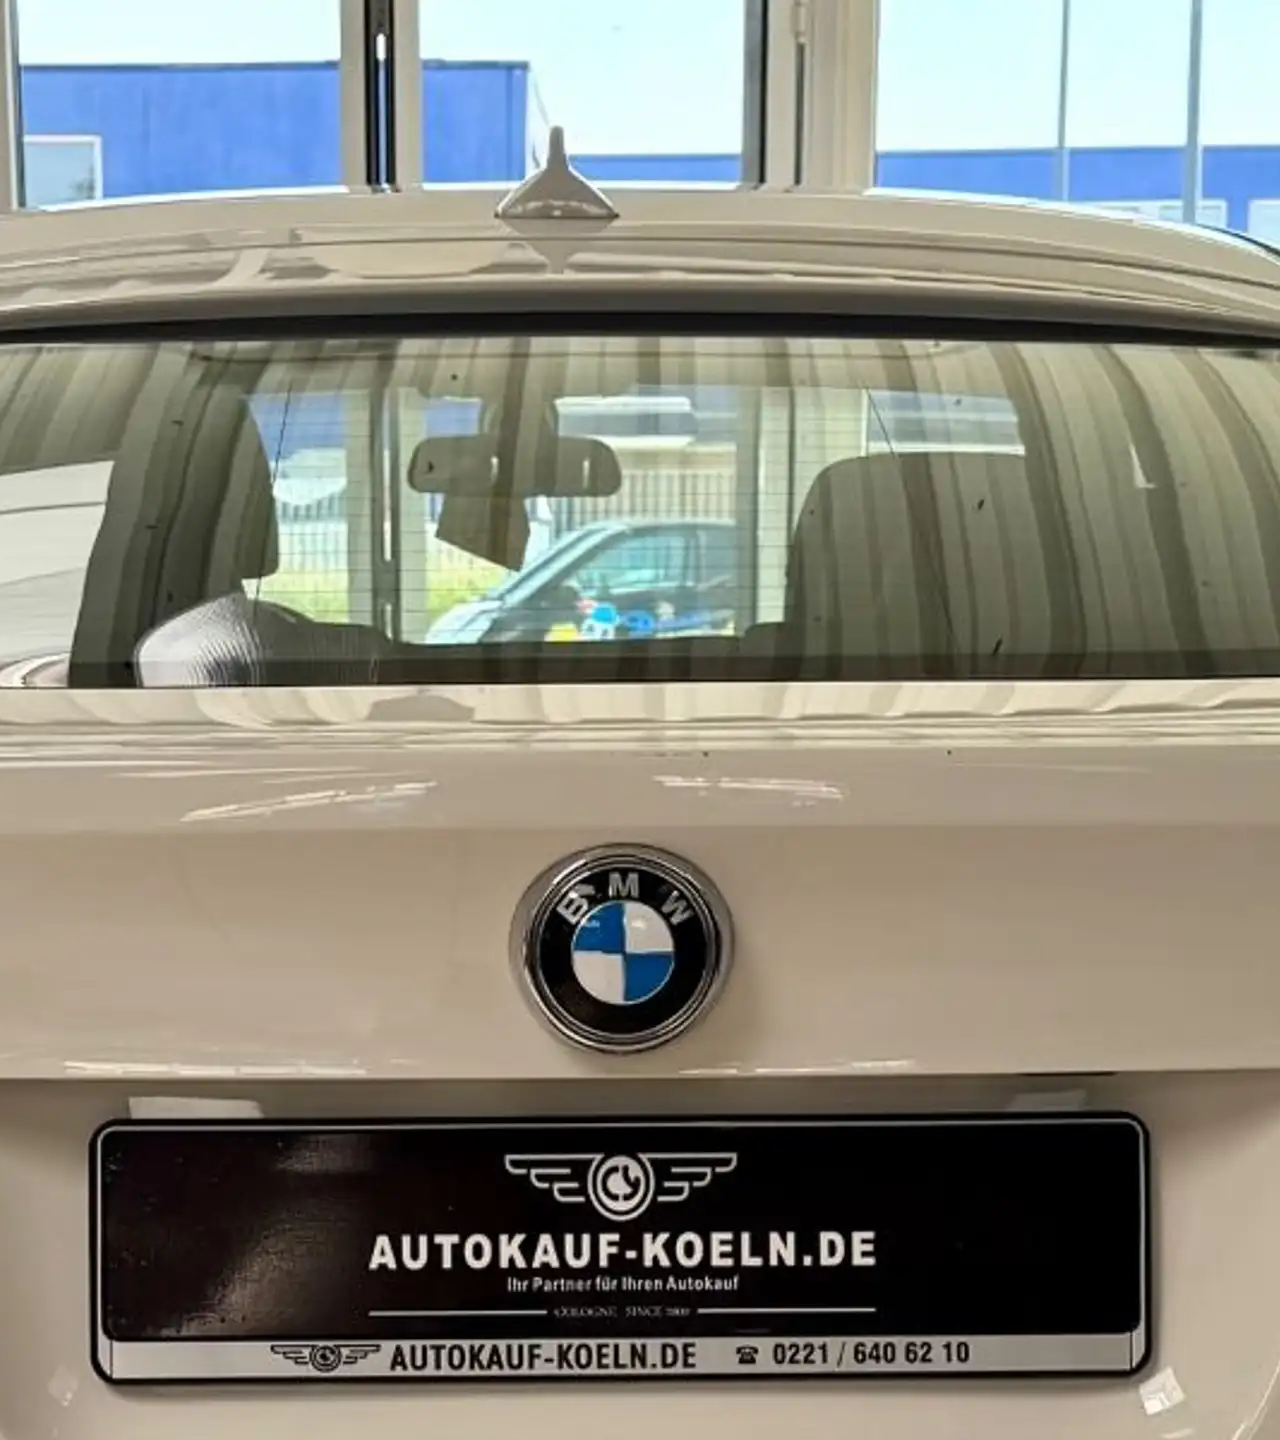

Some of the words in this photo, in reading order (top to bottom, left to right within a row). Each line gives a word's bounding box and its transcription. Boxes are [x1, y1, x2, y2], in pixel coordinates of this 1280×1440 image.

[555, 871, 696, 926] BMW
[368, 1231, 877, 1270] AUTOKAUF-KOELN.DE
[507, 1276, 529, 1292] Ihr
[532, 1276, 592, 1292] Partner
[595, 1275, 618, 1292] für
[622, 1275, 663, 1291] Ihren
[666, 1273, 740, 1291] Autokauf
[389, 1342, 697, 1371] AUTOKAUF-KOELN.DE
[772, 1342, 829, 1365] 0221
[836, 1341, 847, 1368] /
[853, 1341, 897, 1364] 640
[904, 1341, 934, 1364] 62
[943, 1340, 970, 1363] 10
